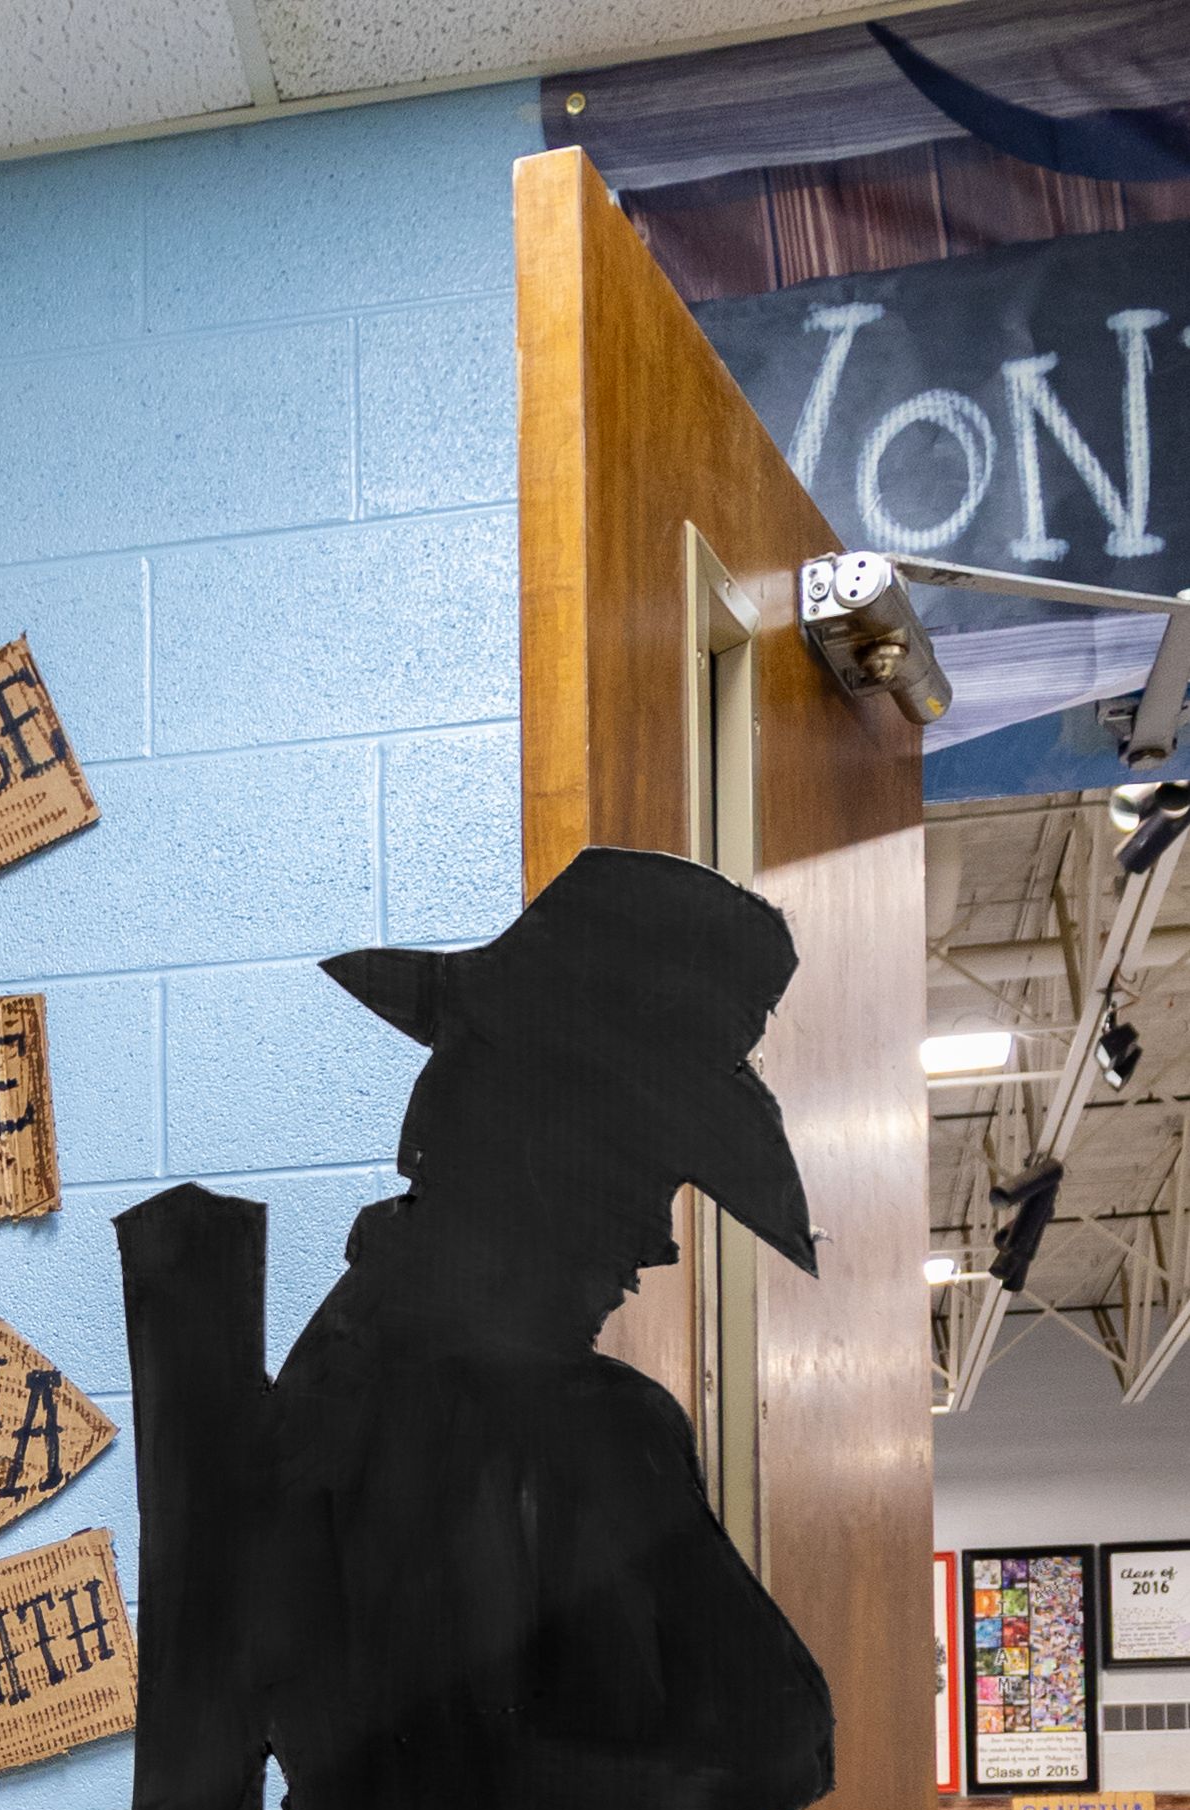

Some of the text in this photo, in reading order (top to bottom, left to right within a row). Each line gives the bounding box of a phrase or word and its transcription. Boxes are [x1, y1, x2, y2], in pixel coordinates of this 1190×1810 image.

[1120, 1566, 1178, 1580] Class of
[1132, 1580, 1170, 1595] 2016
[985, 1764, 1080, 1778] Class of 2015
